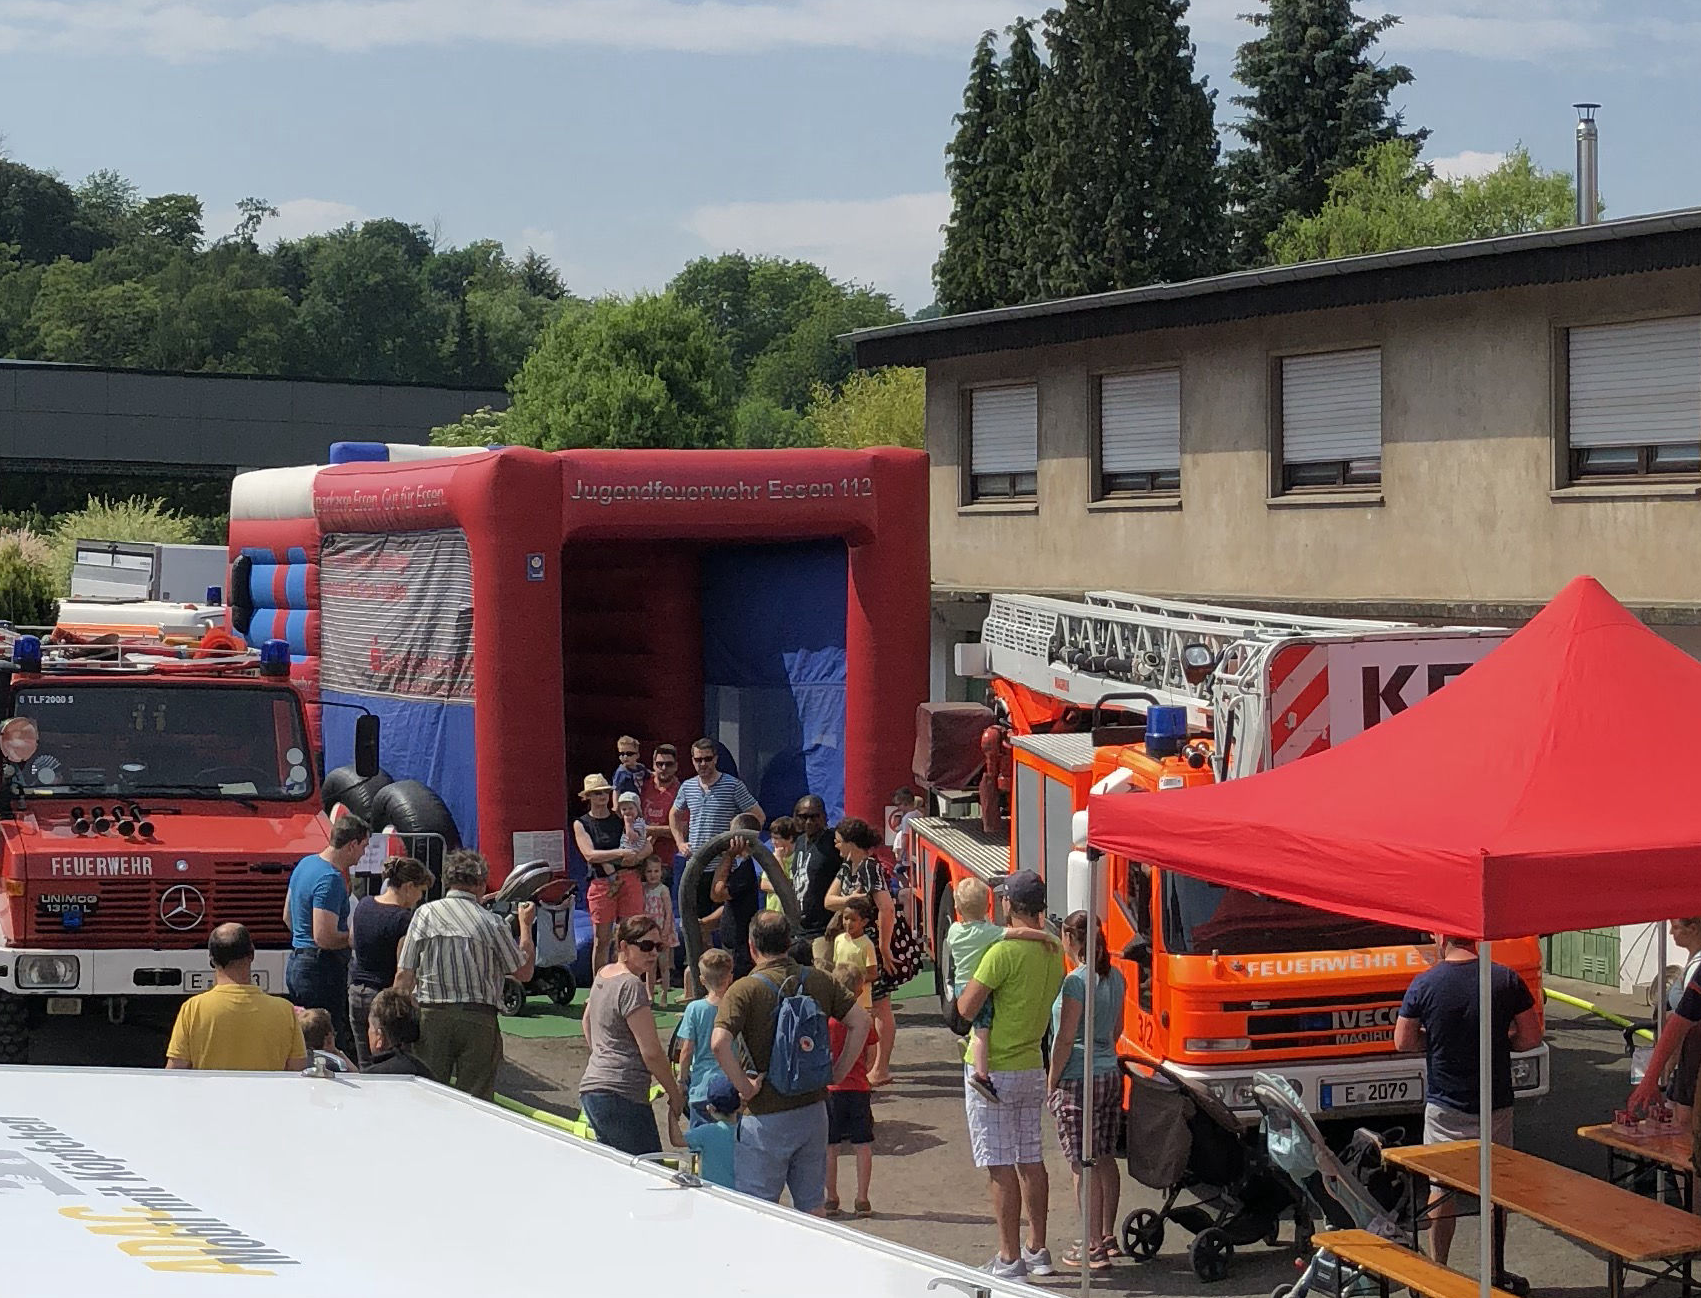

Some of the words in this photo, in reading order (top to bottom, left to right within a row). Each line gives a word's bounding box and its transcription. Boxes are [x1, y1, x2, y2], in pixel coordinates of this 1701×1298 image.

[570, 479, 762, 505] Jugendfeuerwehr
[768, 479, 834, 500] Essen
[839, 477, 873, 498] 112
[51, 856, 153, 876] FEUERWEHR
[41, 894, 98, 904] UNIMOG
[83, 904, 92, 913] L
[1246, 952, 1398, 978] FEUERWEHR
[191, 973, 202, 989] E
[1345, 1086, 1356, 1103] E
[1368, 1082, 1408, 1101] 2079
[95, 1186, 203, 1212] mit
[57, 1205, 279, 1276] ADAC
[145, 1217, 302, 1265] Mobil
